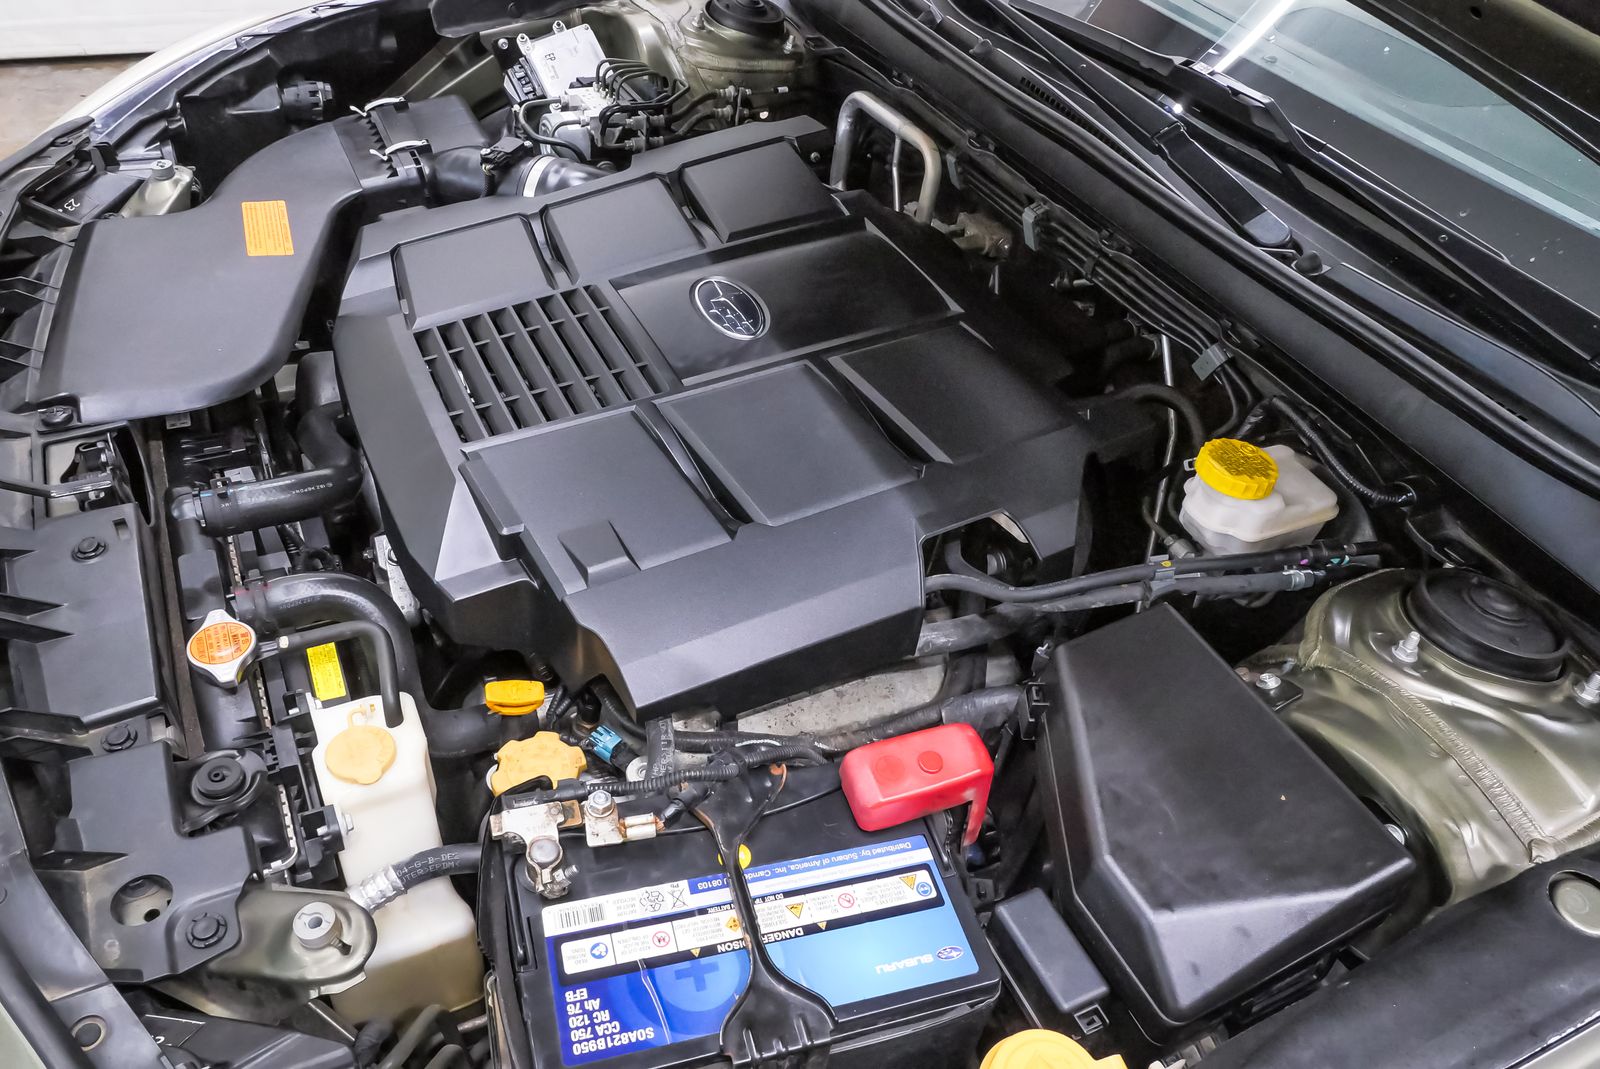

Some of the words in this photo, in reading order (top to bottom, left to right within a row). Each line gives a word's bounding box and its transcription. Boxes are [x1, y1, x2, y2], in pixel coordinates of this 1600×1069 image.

[860, 848, 872, 857] by:
[872, 841, 912, 855] Distributed
[831, 852, 858, 862] Subaru
[772, 867, 787, 875] Inc.
[788, 859, 821, 870] America,
[744, 869, 772, 880] Camde
[697, 879, 722, 890] 08103
[765, 894, 775, 903] NOT
[761, 927, 804, 943] DANGER
[716, 939, 746, 953] ISON
[875, 953, 934, 974] SUBARU
[565, 987, 588, 1002] EFB
[566, 1002, 583, 1015] 76
[584, 998, 600, 1011] Ah
[568, 1013, 590, 1028] 120
[592, 1009, 610, 1023] RC
[570, 1027, 594, 1041] 750
[594, 1021, 620, 1036] CCA
